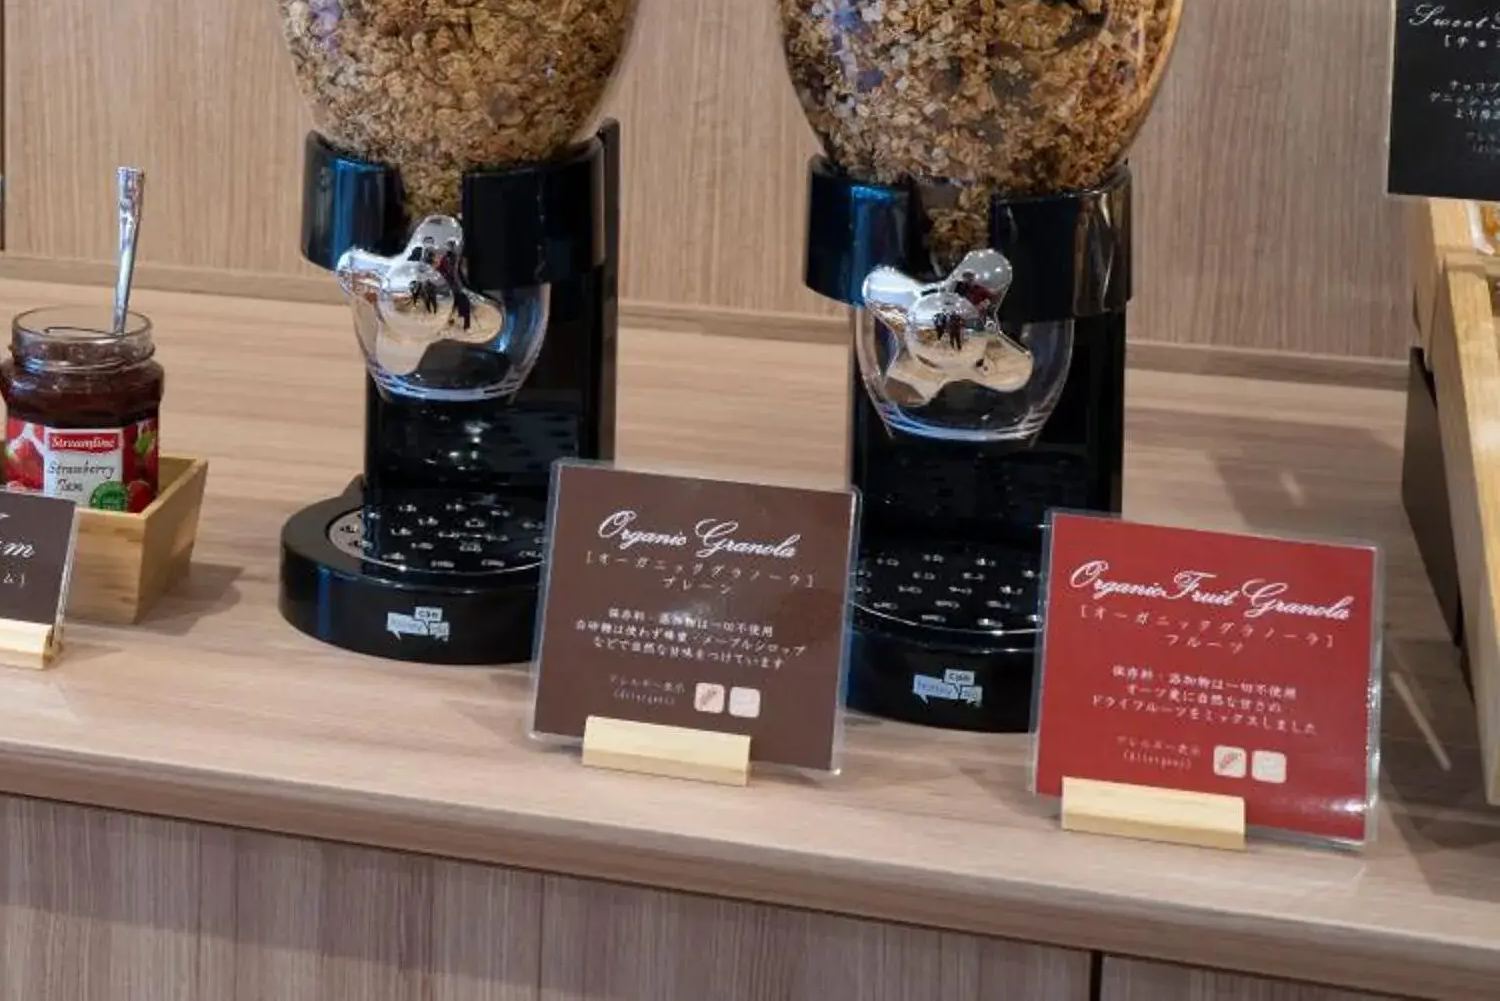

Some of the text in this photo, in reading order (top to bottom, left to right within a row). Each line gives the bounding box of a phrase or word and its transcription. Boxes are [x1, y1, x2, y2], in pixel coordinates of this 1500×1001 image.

[1408, 3, 1489, 29] Sweet
[51, 437, 116, 452] Streamline
[48, 459, 115, 480] Strawberry
[598, 509, 801, 559] Organic Granola
[1070, 560, 1355, 621] Organic Fruit Granola
[1166, 634, 1245, 654] フルーツ
